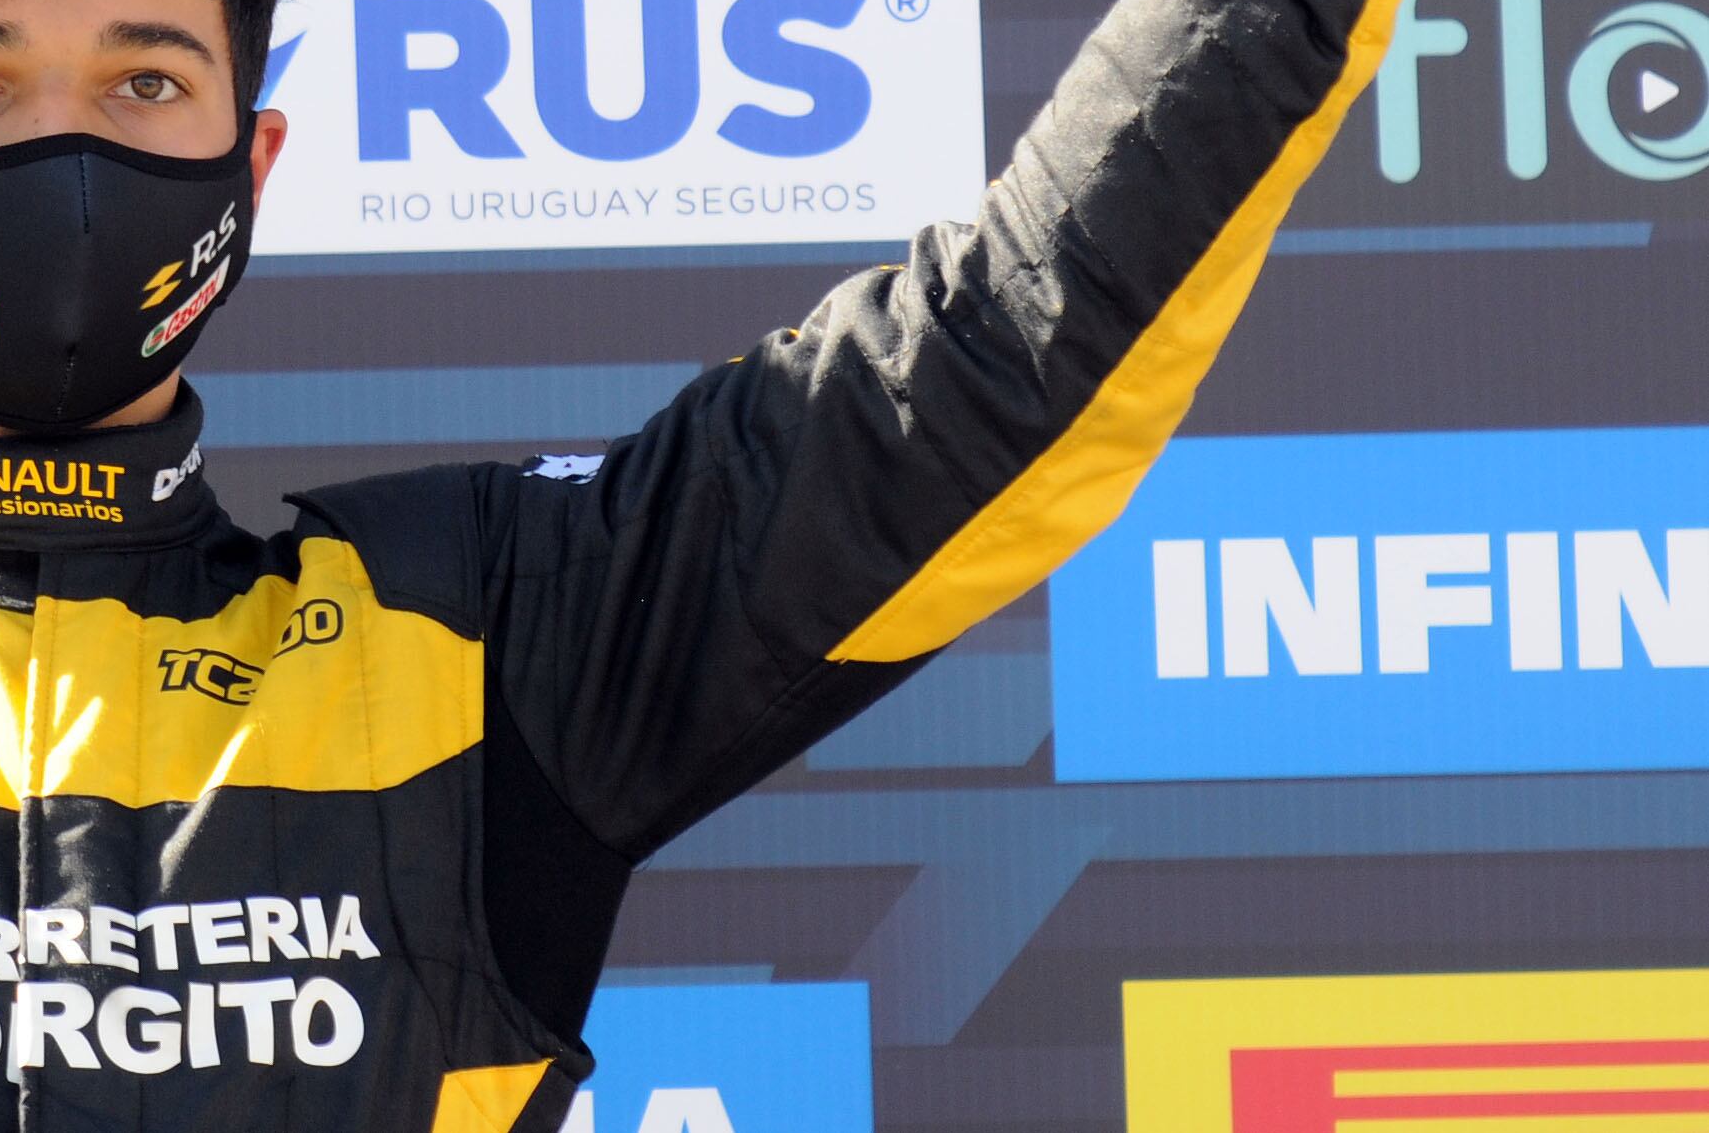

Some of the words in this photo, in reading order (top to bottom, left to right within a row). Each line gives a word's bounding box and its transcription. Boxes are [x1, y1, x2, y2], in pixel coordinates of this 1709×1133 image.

[361, 193, 431, 222] RIO
[452, 188, 659, 220] URUGUAY
[675, 183, 877, 215] SEGUROS
